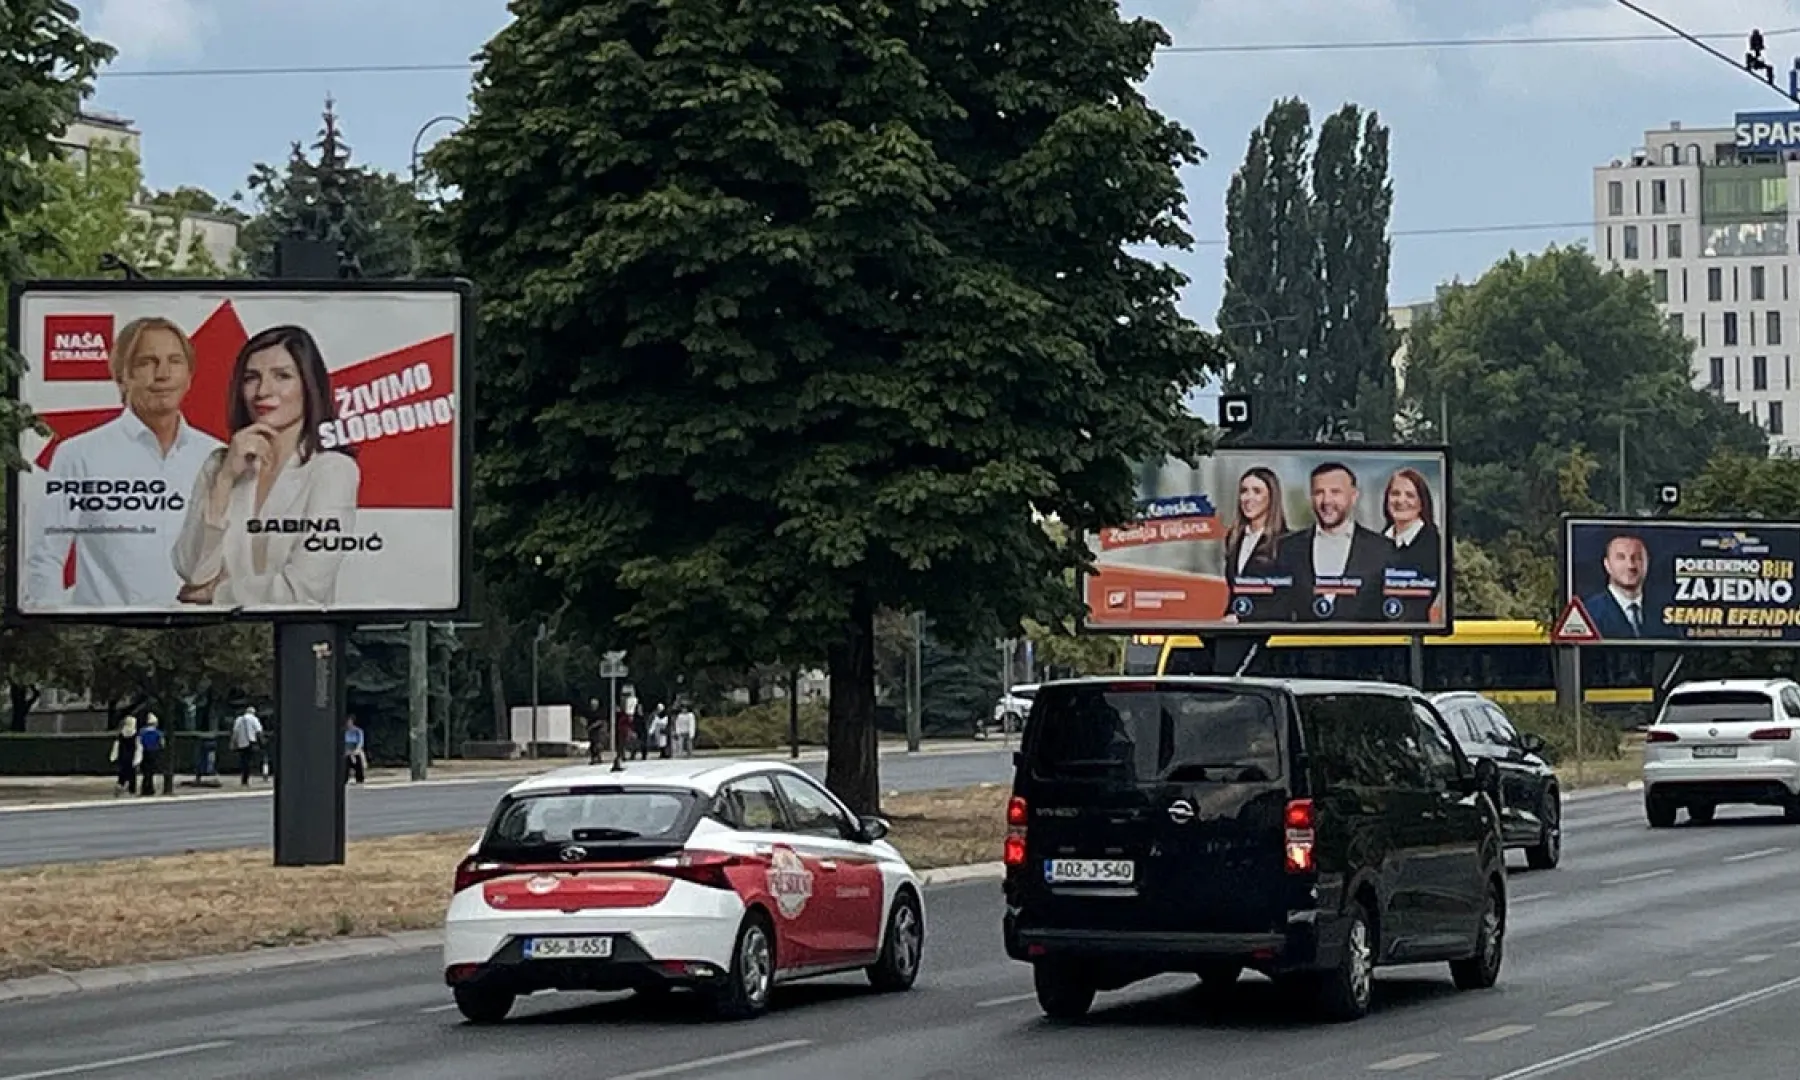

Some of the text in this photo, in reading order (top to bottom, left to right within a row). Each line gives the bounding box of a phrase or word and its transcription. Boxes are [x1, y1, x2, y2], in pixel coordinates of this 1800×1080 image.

[55, 331, 105, 349] NAŠA
[334, 362, 432, 419] ŽIVIMO
[46, 480, 166, 494] PREDRAG
[69, 491, 184, 511] KOJOVIĆ
[247, 518, 341, 533] SABINA
[304, 532, 383, 551] ĆUDIĆ
[1675, 577, 1793, 603] ZAJEDNO
[1662, 607, 1724, 625] SEMIR
